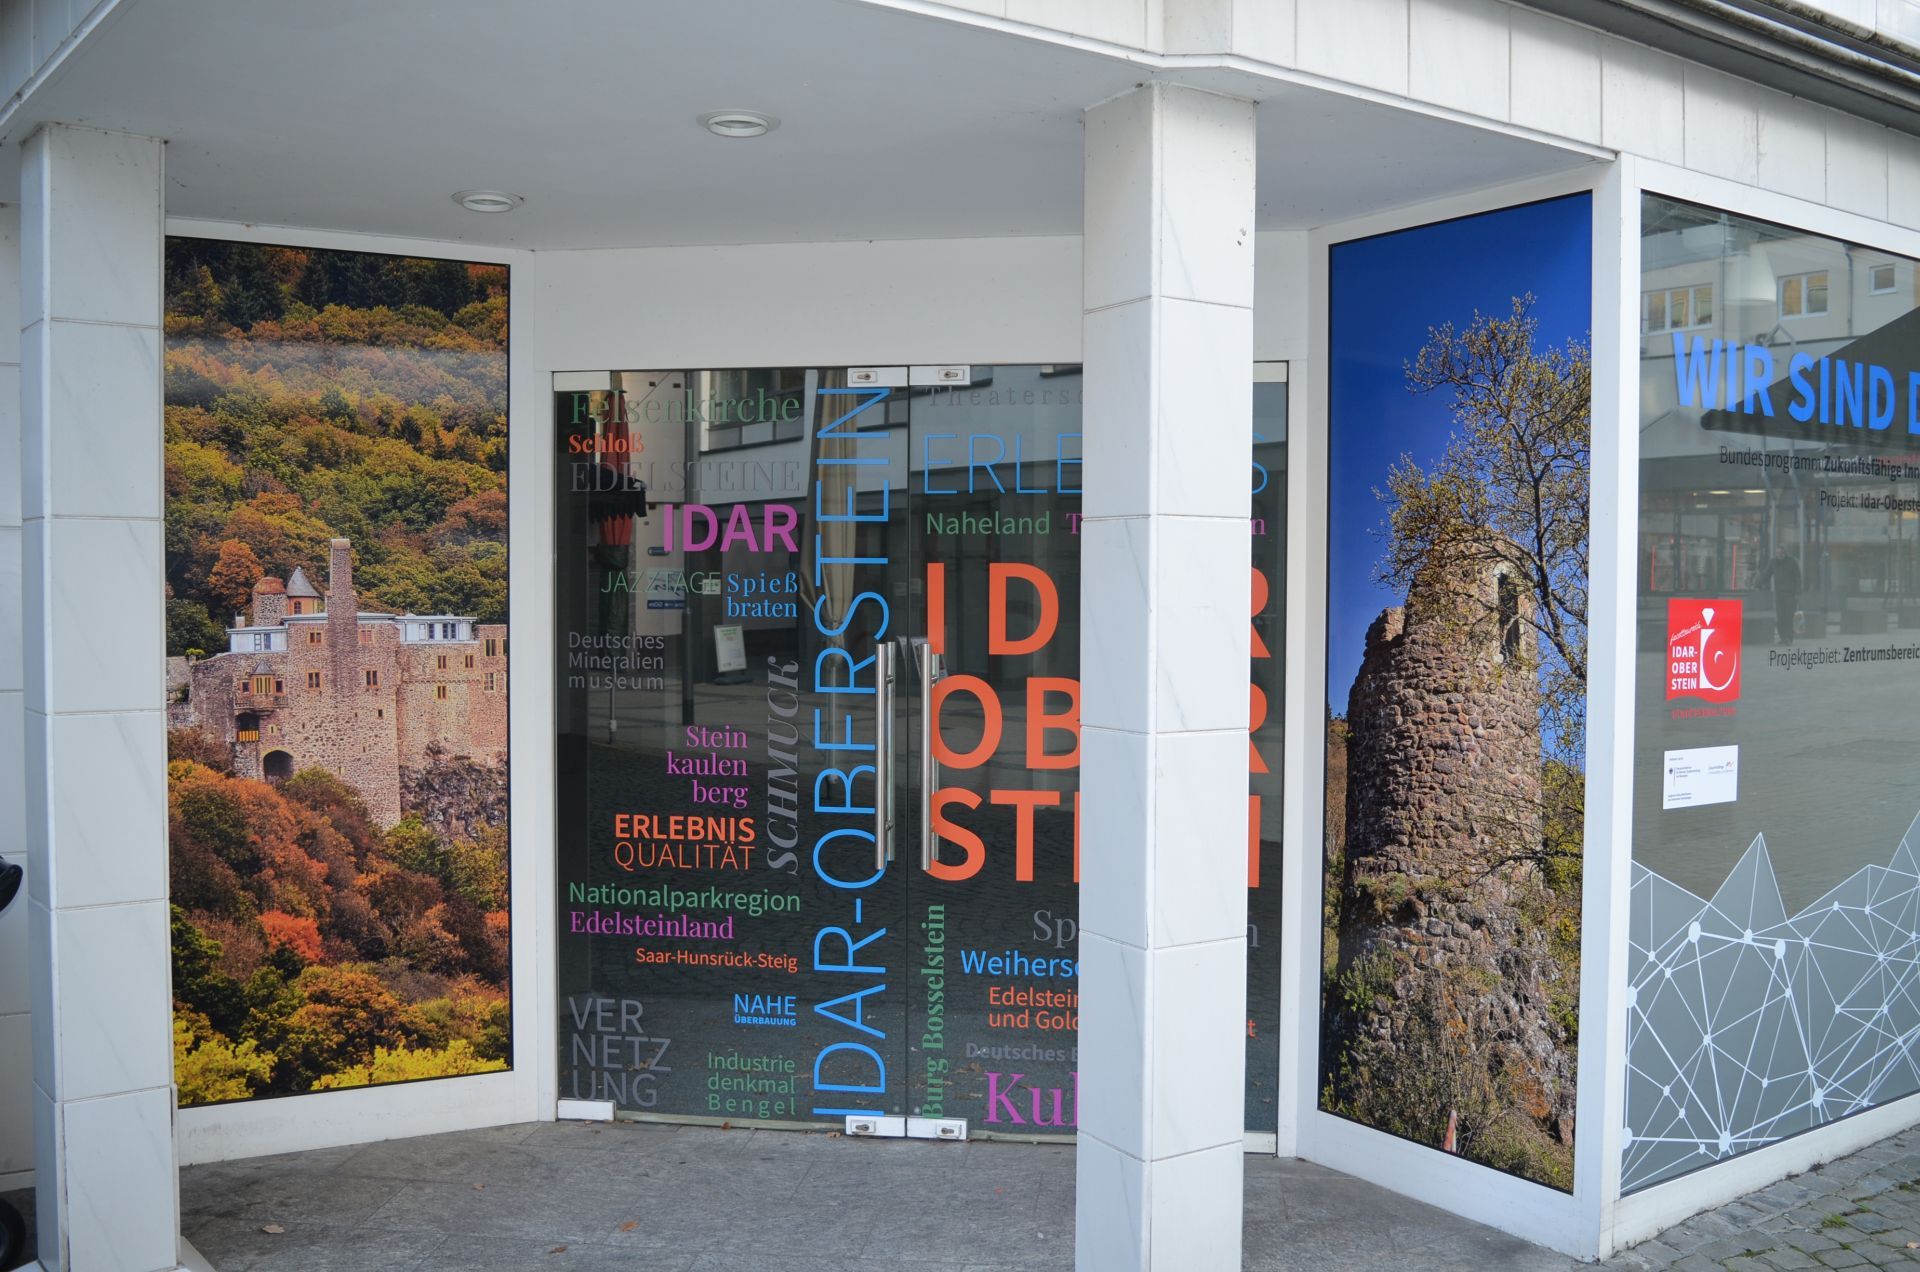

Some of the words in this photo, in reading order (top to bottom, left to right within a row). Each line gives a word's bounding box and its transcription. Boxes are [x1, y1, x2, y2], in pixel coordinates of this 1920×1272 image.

[1672, 331, 1775, 417] WIR
[1788, 351, 1895, 430] SIND
[569, 387, 801, 426] Felsenkirche
[568, 432, 645, 455] Schloß
[569, 459, 801, 493] EDELSTEINE
[1824, 455, 1902, 482] Zukunftsfähige
[1820, 490, 1859, 513] Projekt:
[662, 503, 800, 553] IDAR
[926, 511, 1050, 535] Naheland
[727, 571, 799, 597] Spieß
[727, 597, 799, 618] braten
[568, 631, 665, 650] Deutsches
[1672, 645, 1698, 658] IDAR-
[568, 652, 664, 670] Mineralien
[1672, 661, 1698, 674] OBER
[1769, 646, 1842, 671] Projektgebiet:
[568, 673, 664, 690] museum
[1671, 677, 1698, 691] STEIN
[686, 725, 748, 748] Stein
[666, 751, 748, 776] kaulen
[812, 388, 890, 1116] IDAR-OBERSTEIN
[766, 655, 799, 876] SCHMUCK
[692, 779, 749, 809] berg
[614, 814, 756, 843] ERLEBNIS
[614, 840, 756, 871] QUALITÄT
[569, 881, 800, 917] Nationalparkregion
[570, 910, 735, 940] Edelsteinland
[635, 947, 798, 974] Saar-Hunsrück-Steig
[921, 903, 945, 1050] Bosselstein
[568, 996, 644, 1033] VER
[734, 993, 797, 1016] NAHE
[734, 1015, 797, 1027] ÜBERBAUUNG
[988, 1012, 1029, 1029] und
[572, 1033, 672, 1072] NETZ
[707, 1051, 796, 1073] Industrie
[965, 1042, 1066, 1063] Deutsches
[572, 1070, 659, 1108] UNG
[707, 1074, 796, 1095] denkmal
[922, 1056, 949, 1119] Burg
[707, 1094, 796, 1119] Bengel
